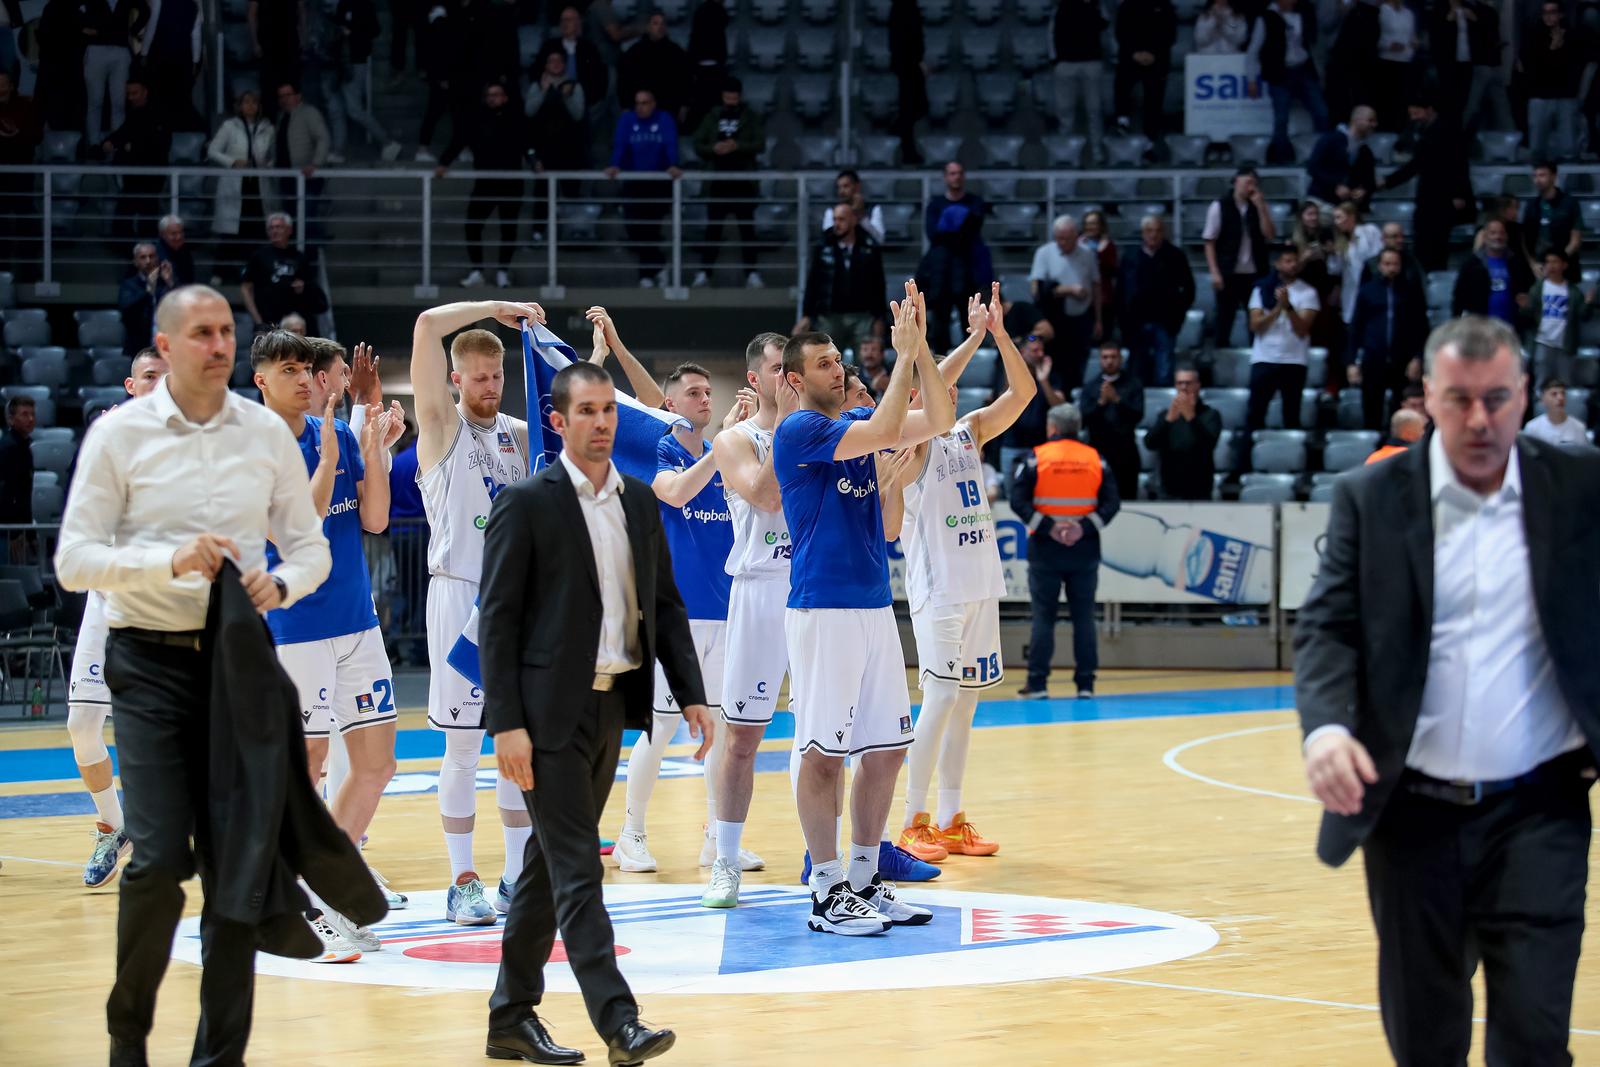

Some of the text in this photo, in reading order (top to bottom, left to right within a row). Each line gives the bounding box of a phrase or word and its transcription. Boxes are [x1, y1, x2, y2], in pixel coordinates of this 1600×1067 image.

[1194, 73, 1263, 100] san
[936, 455, 977, 482] ZADA
[956, 479, 981, 508] 19
[773, 544, 792, 560] PS
[1212, 540, 1244, 600] santa
[976, 652, 1000, 683] 19
[372, 678, 394, 714] 2
